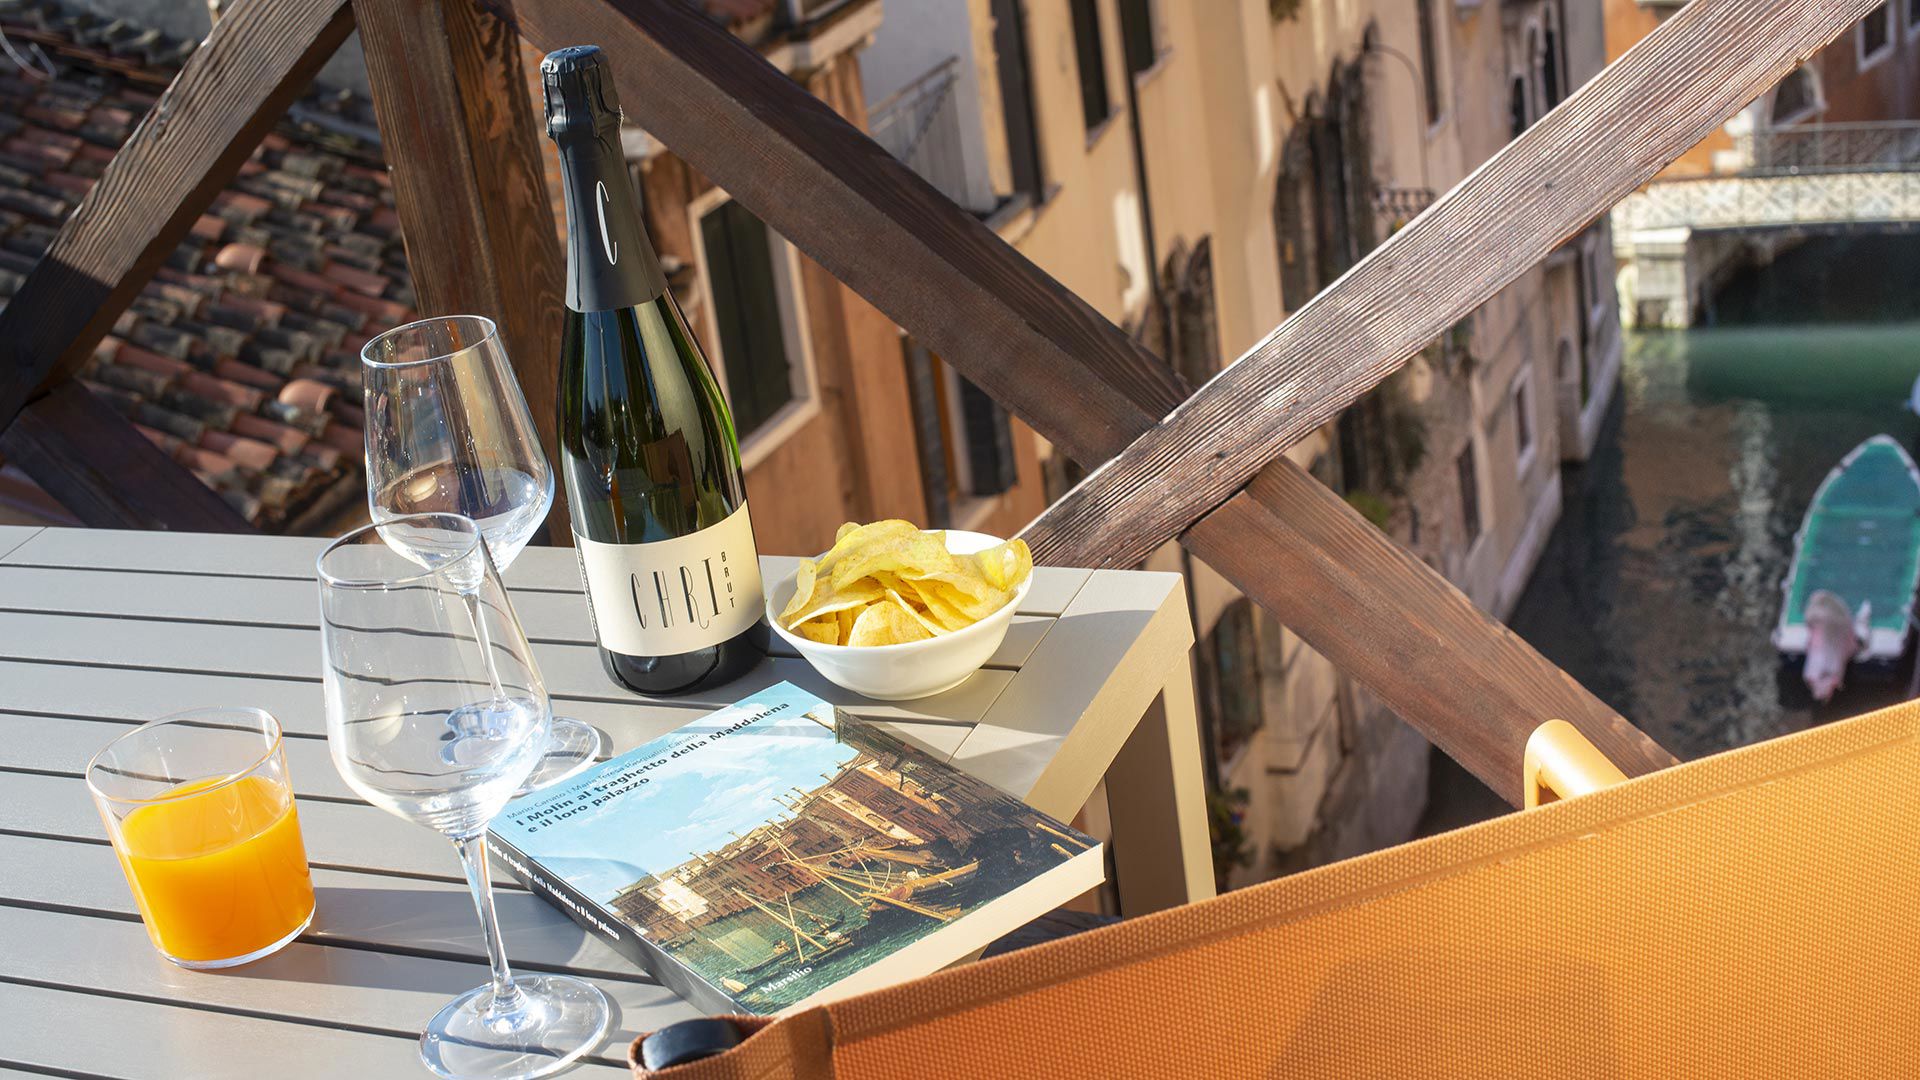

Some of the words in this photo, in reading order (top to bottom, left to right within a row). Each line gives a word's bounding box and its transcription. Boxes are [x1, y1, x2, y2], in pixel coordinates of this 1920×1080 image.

[596, 180, 618, 266] C
[631, 557, 722, 630] CHRI
[721, 551, 735, 608] BRUT
[527, 799, 574, 822] Molin
[576, 790, 592, 801] al
[594, 758, 668, 793] traghetto
[670, 740, 707, 759] della
[709, 702, 790, 742] Maddalena
[506, 806, 533, 820] Mario
[534, 792, 566, 808] Canato
[571, 778, 597, 793] Maria
[598, 767, 624, 779] Teresa
[539, 818, 553, 828] il
[554, 805, 588, 821] loro
[591, 777, 650, 807] palazzo
[760, 966, 812, 994] Marsilio
